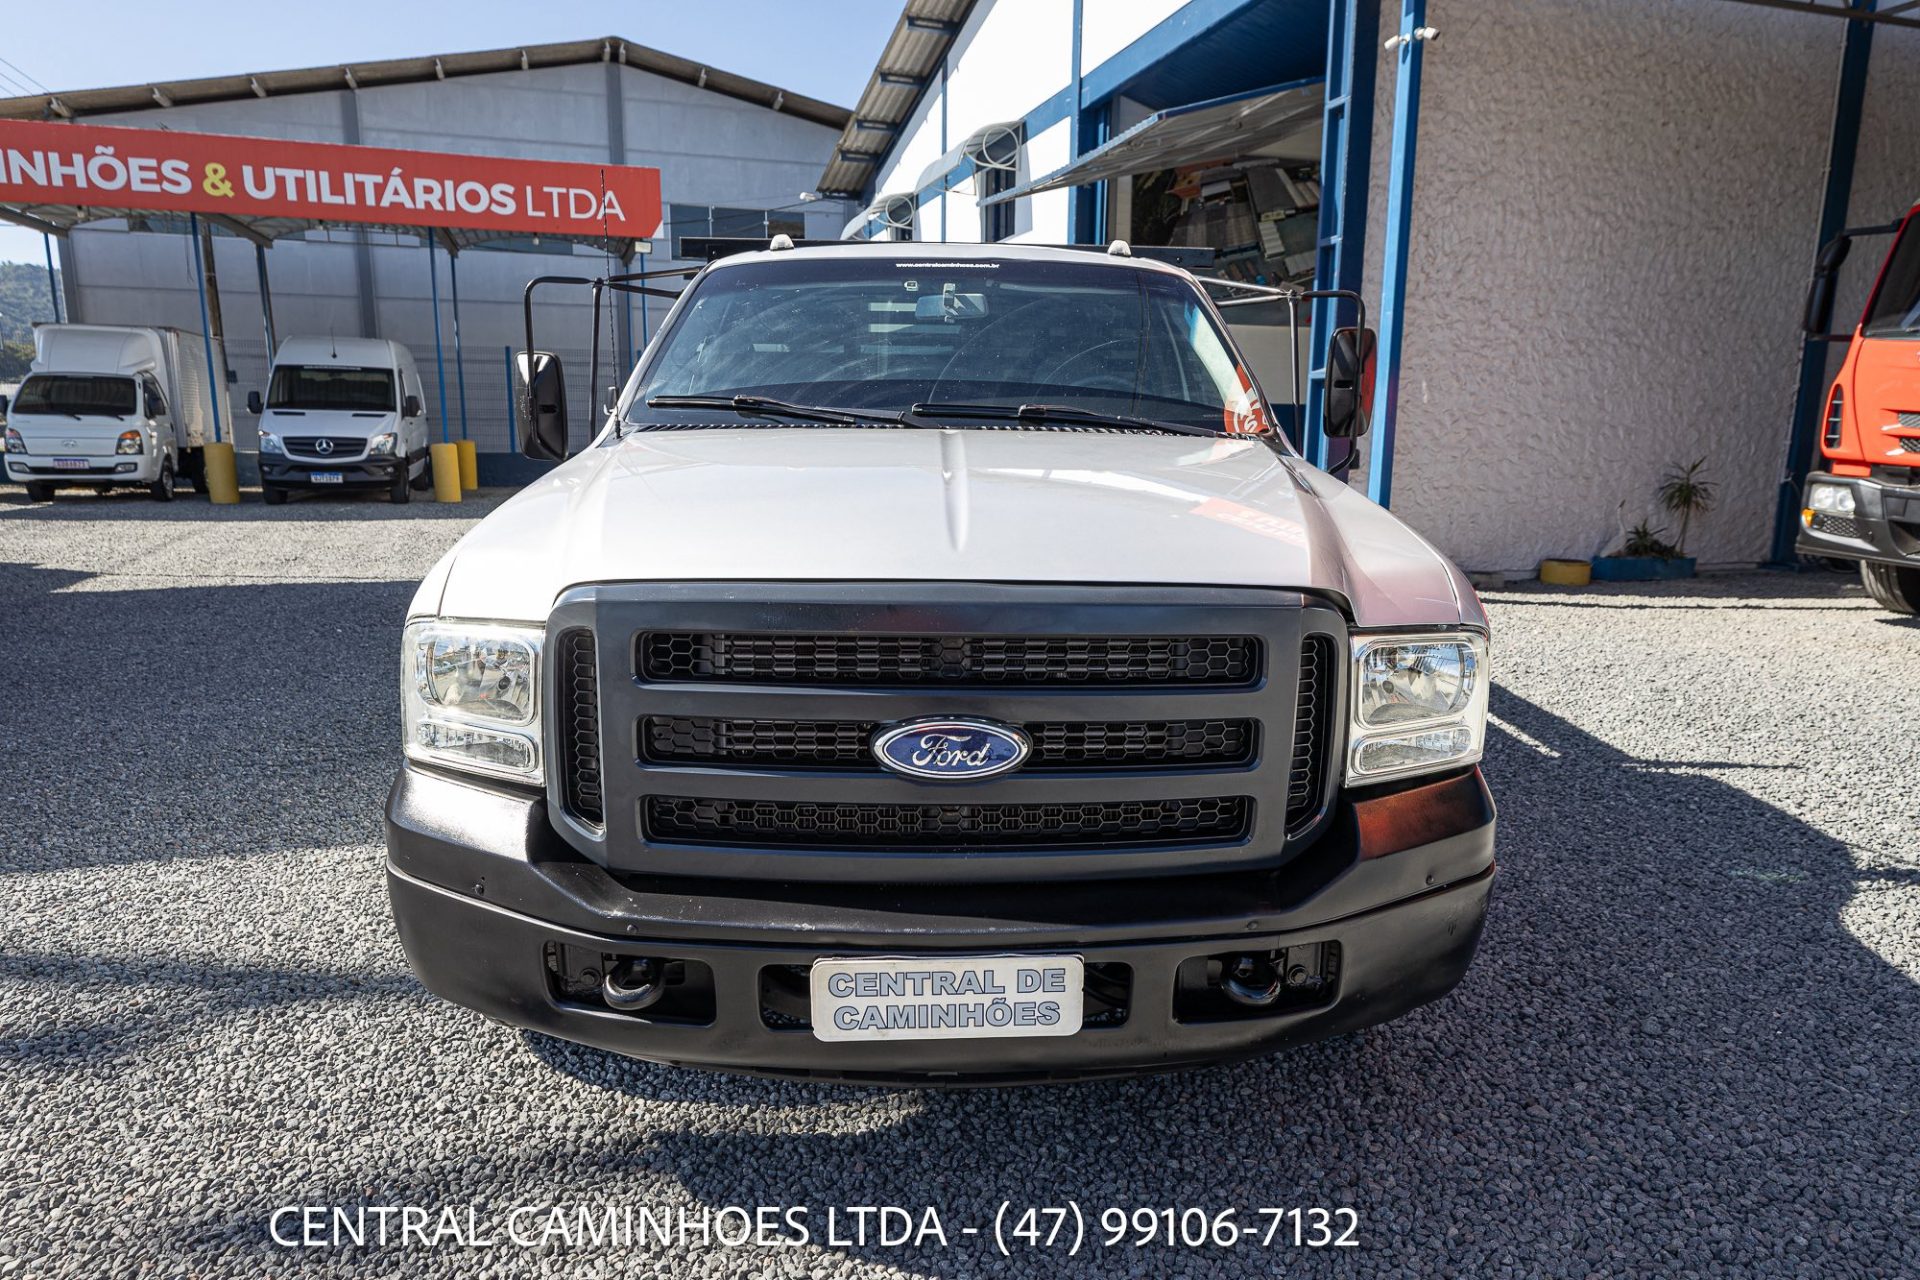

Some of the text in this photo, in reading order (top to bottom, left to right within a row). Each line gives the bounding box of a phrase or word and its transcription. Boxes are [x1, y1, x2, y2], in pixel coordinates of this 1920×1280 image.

[202, 162, 235, 198] &
[242, 165, 517, 216] UTILITÁRIOS
[526, 185, 626, 222] LTDA
[911, 733, 991, 767] Ford
[828, 968, 1066, 997] CENTRAL DE
[833, 998, 1060, 1031] CAMINHÕES
